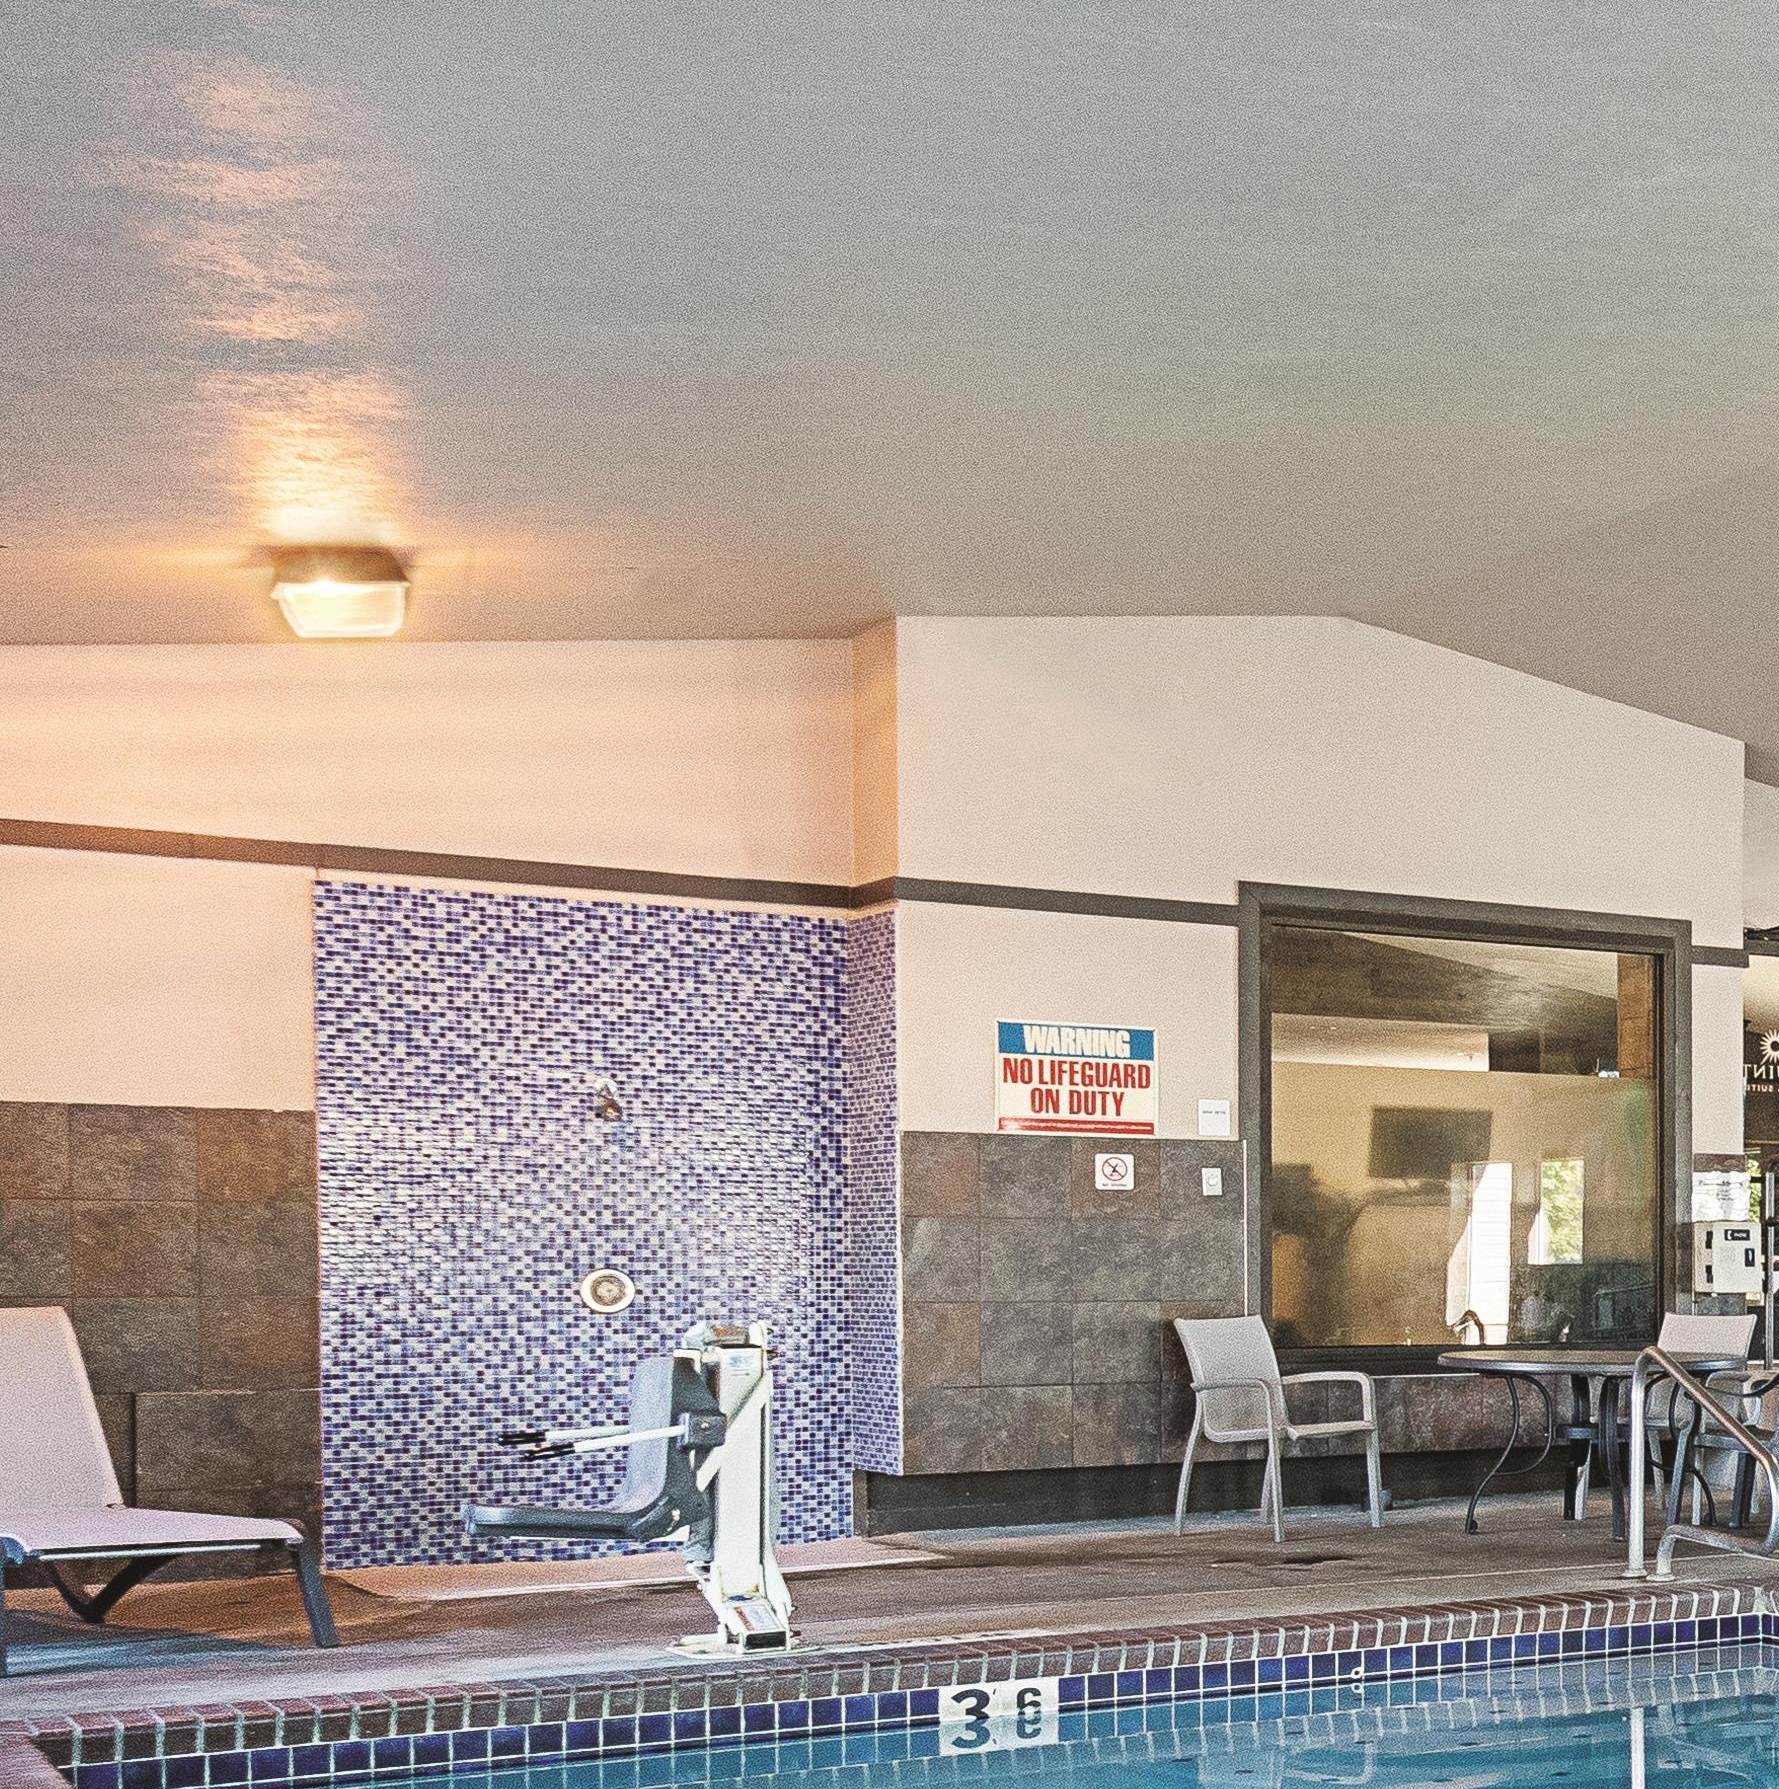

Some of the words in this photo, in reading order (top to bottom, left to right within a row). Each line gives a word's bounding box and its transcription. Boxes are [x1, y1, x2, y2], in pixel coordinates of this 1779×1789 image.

[1023, 1024, 1131, 1058] WARNING
[1002, 1057, 1034, 1085] NO
[1038, 1059, 1151, 1090] LIFEGUARD
[1030, 1087, 1061, 1115] ON
[1068, 1089, 1126, 1118] DUTY
